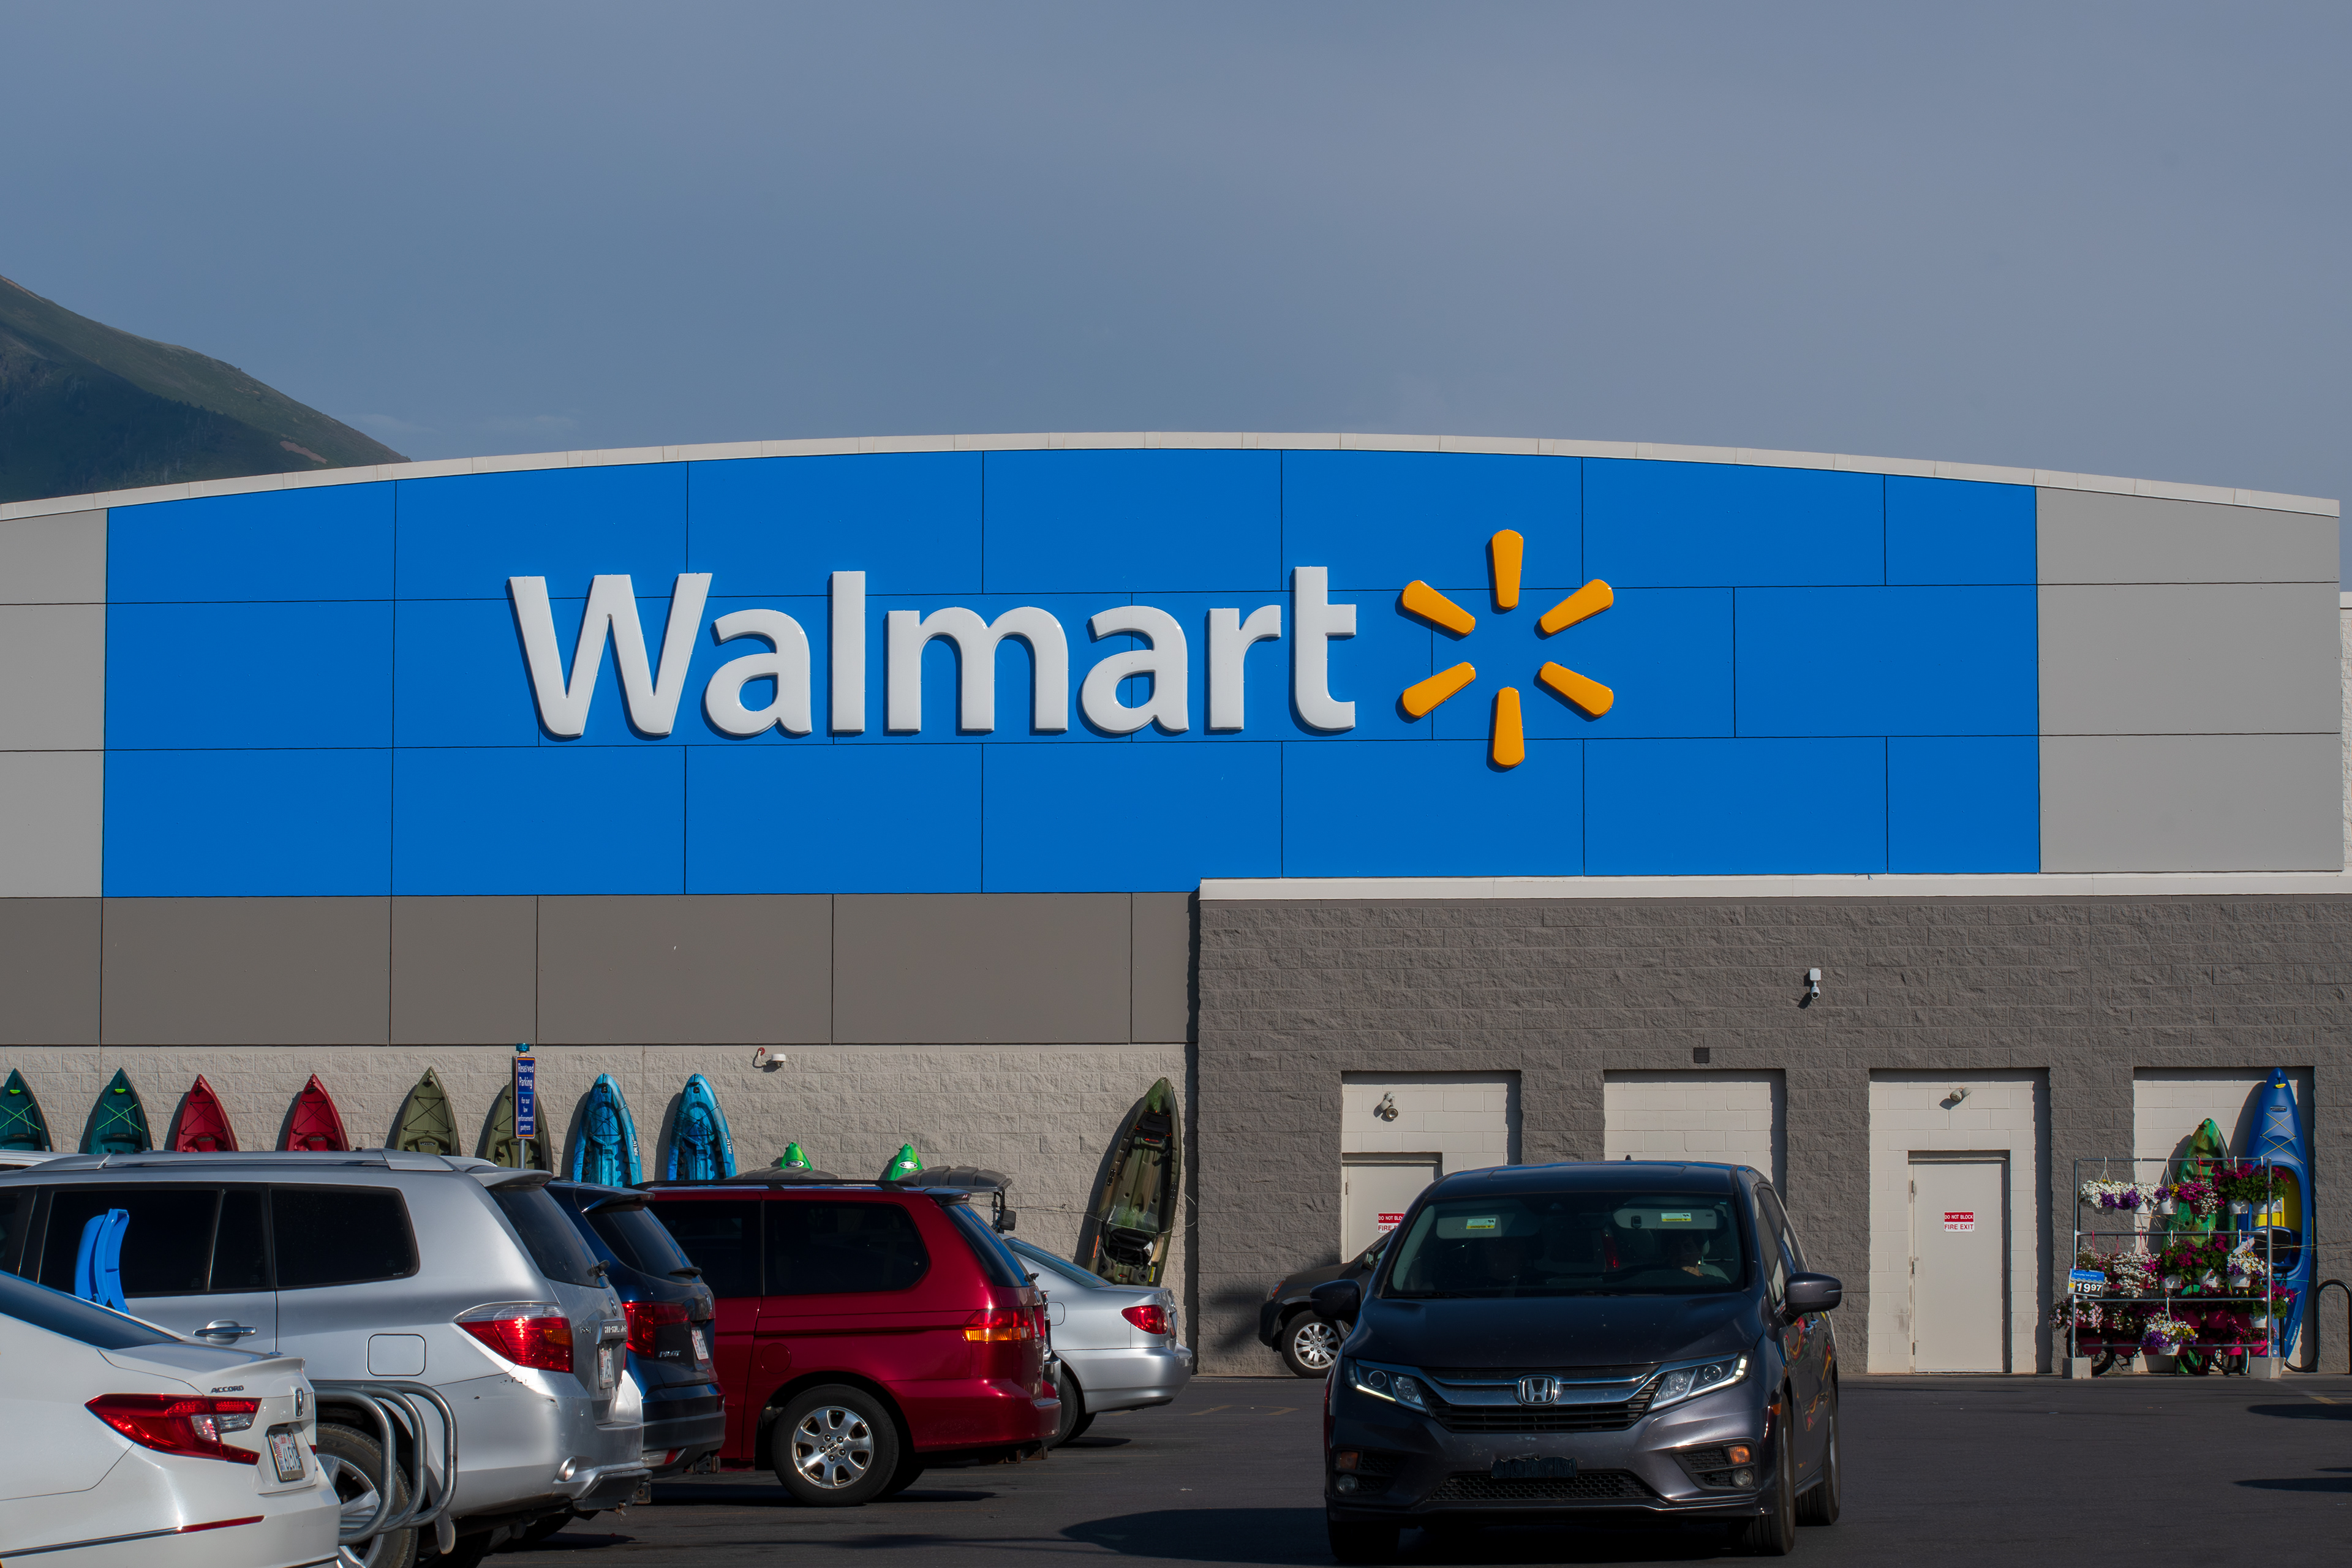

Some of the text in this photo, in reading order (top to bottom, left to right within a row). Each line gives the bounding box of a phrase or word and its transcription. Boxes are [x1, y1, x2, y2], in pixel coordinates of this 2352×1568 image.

[510, 567, 1356, 737] Walmart
[518, 1063, 534, 1073] Reserved
[519, 1077, 533, 1089] Parking
